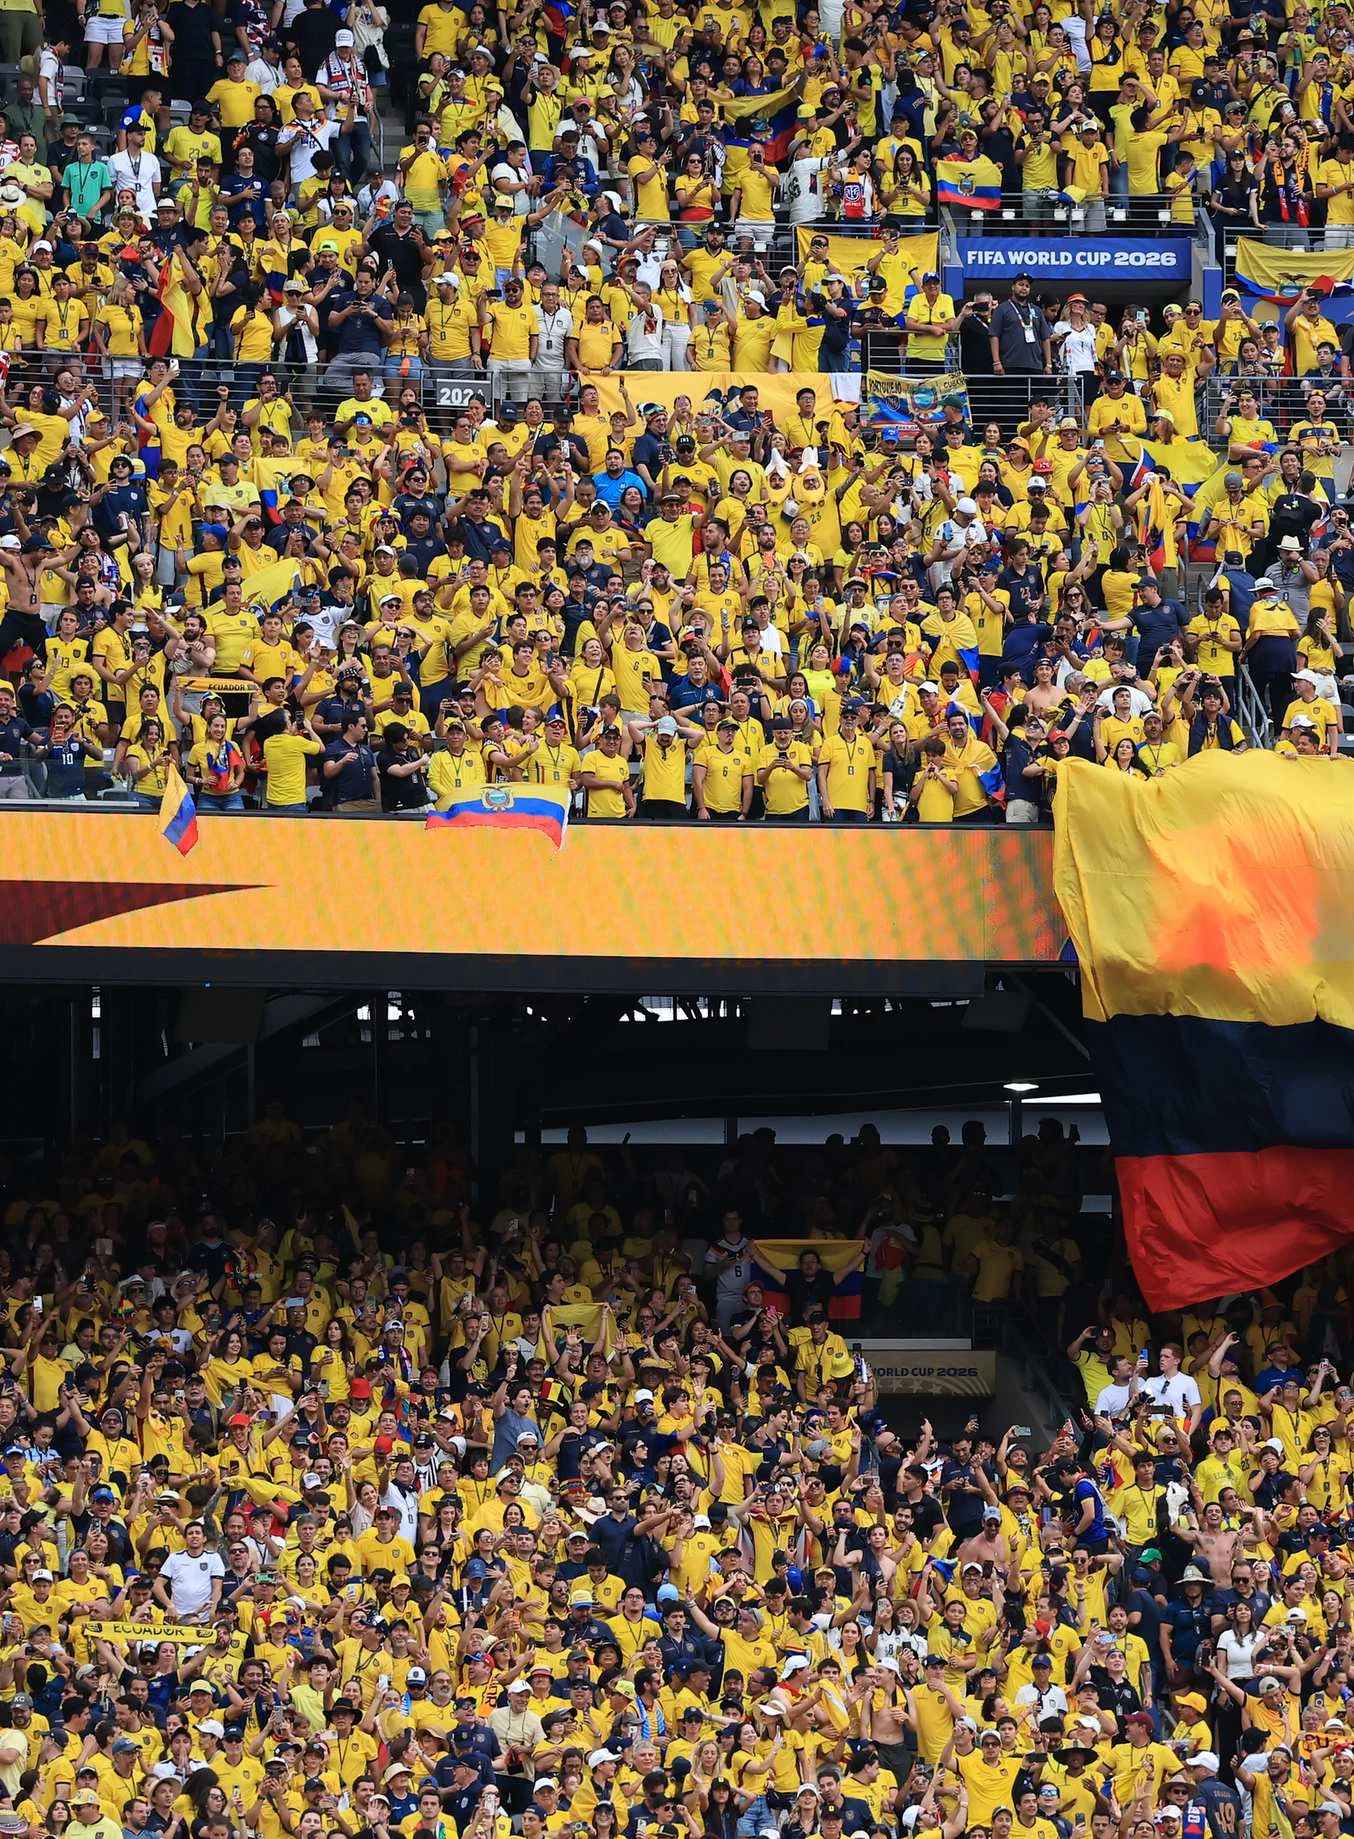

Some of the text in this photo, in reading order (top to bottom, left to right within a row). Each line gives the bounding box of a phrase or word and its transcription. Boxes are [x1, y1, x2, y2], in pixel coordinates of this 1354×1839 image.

[967, 250, 1177, 267] FIFA WORLD CUP 2026
[1233, 331, 1242, 342] 23
[439, 387, 486, 406] 202
[811, 512, 821, 524] 23
[61, 656, 70, 668] 13
[633, 661, 639, 671] 6
[208, 683, 245, 691] ECUADOR
[62, 753, 73, 765] 10
[723, 767, 728, 777] 6
[735, 1265, 742, 1277] 6
[911, 1367, 934, 1377] CUP
[937, 1367, 978, 1377] 2026
[113, 1623, 185, 1637] ECUADOR
[13, 1695, 25, 1703] KC
